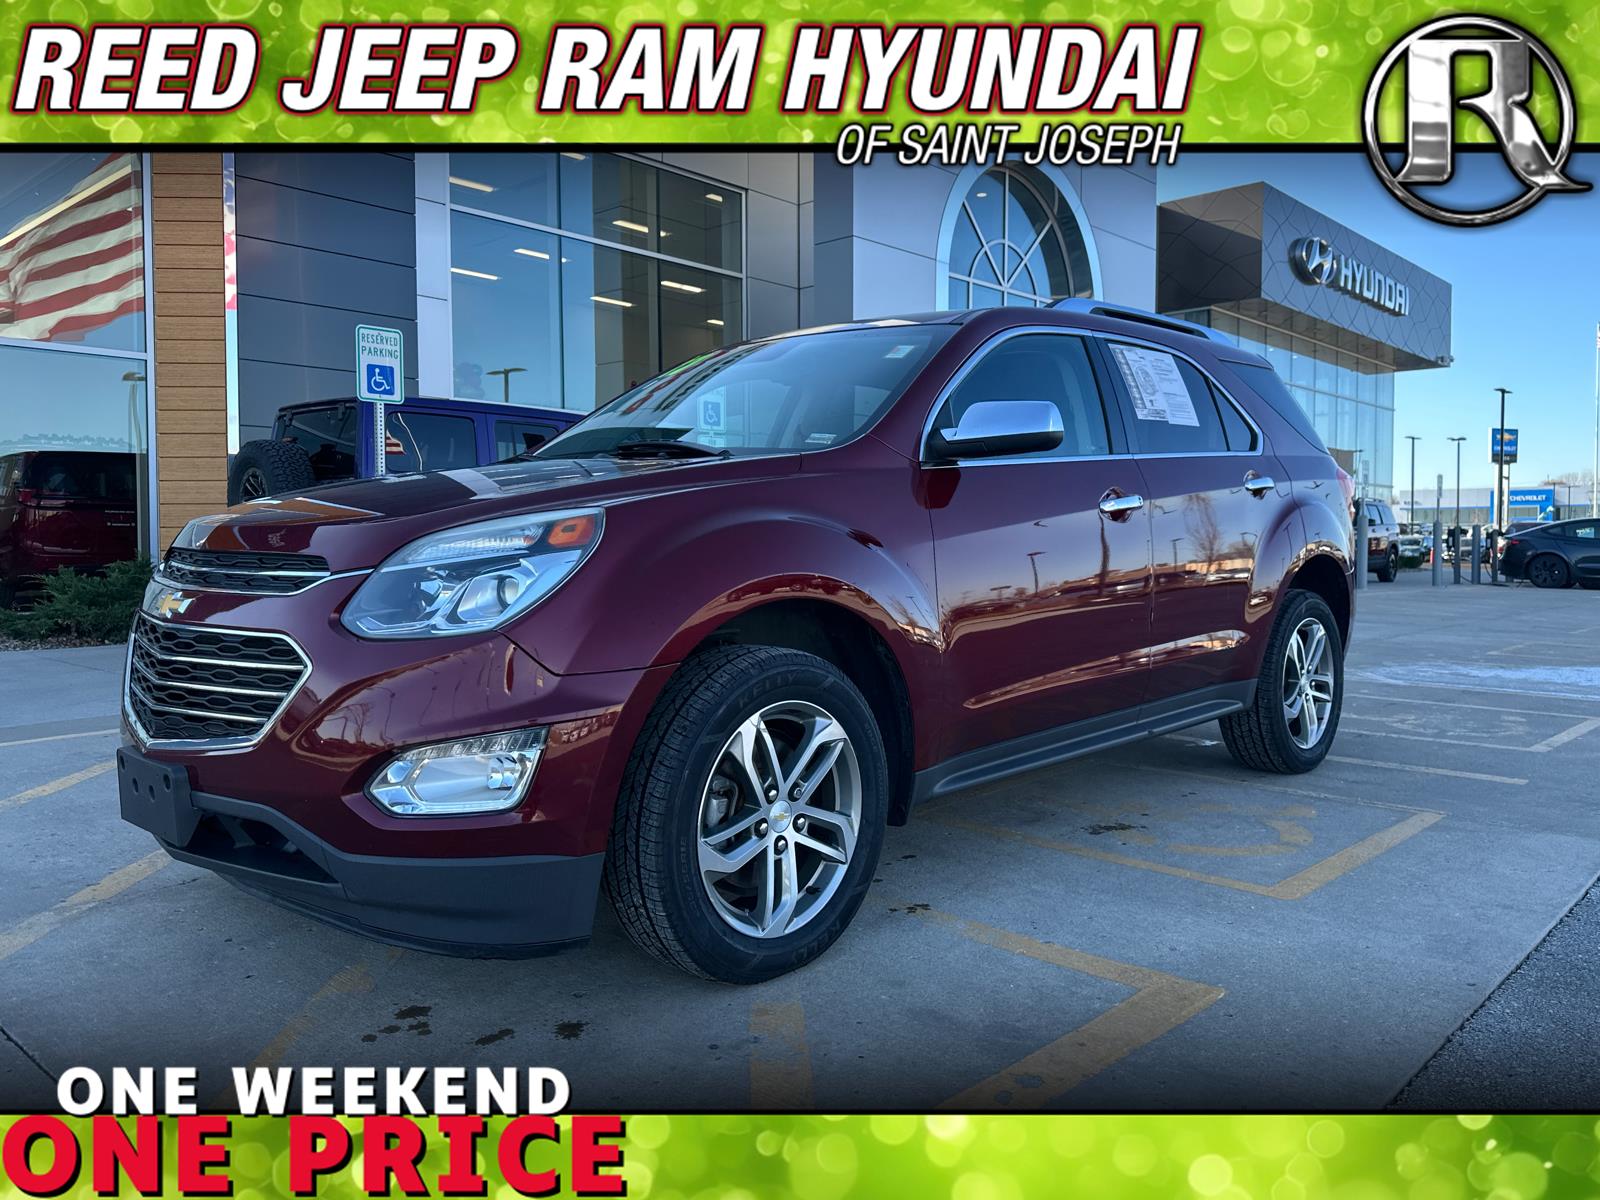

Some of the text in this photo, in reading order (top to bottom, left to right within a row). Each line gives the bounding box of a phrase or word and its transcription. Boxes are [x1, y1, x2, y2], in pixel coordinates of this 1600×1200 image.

[1340, 254, 1409, 316] HYUNDAI
[361, 333, 398, 347] RESERVED
[361, 345, 399, 360] PARKING
